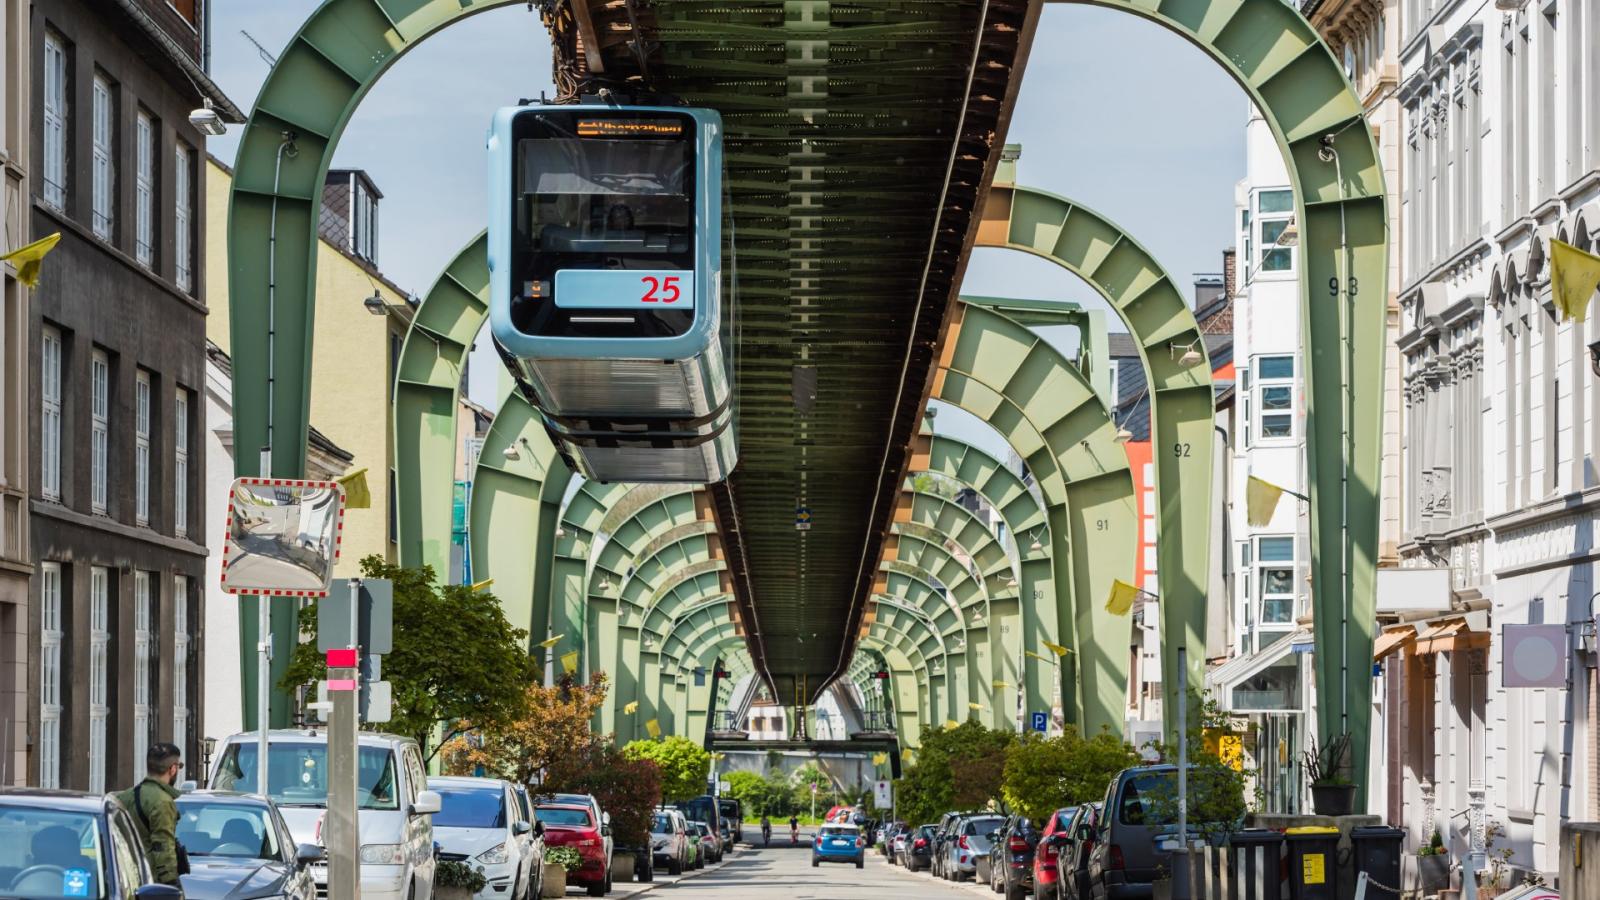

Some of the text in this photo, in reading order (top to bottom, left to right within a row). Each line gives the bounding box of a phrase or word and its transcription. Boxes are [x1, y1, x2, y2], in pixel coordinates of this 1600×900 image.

[641, 276, 680, 303] 25
[1328, 276, 1359, 297] 93
[1174, 443, 1191, 457] 92
[1096, 519, 1109, 531] 91
[1035, 714, 1044, 729] P
